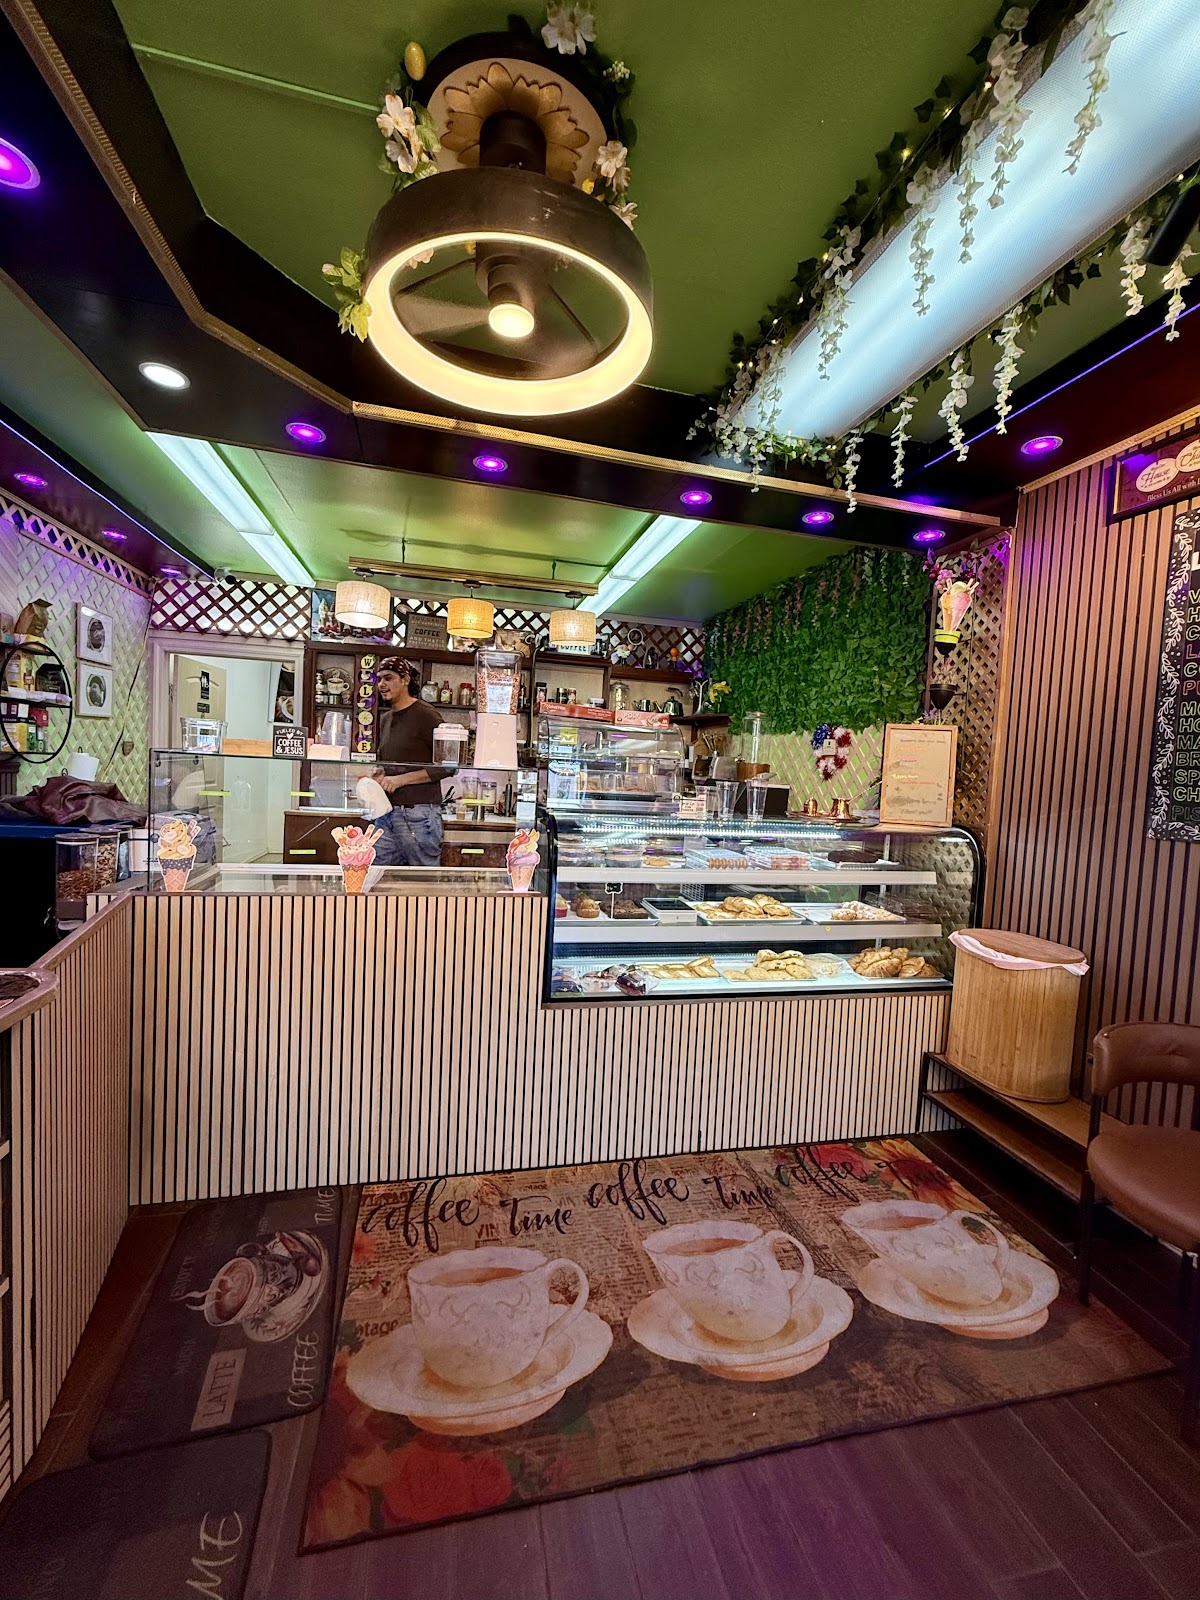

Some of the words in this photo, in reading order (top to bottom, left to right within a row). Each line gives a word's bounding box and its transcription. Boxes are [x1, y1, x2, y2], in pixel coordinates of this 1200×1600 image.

[1147, 494, 1163, 502] Bless
[1163, 489, 1172, 497] Us
[1171, 485, 1182, 494] All
[1182, 480, 1197, 490] with
[414, 628, 441, 637] COFFEE
[275, 745, 283, 754] &
[283, 746, 304, 755] JESUS
[278, 738, 302, 747] COFFEE
[314, 1188, 335, 1225] TIME
[586, 1158, 690, 1225] coffee
[702, 1173, 776, 1210] Time
[361, 1177, 480, 1253] coffee
[499, 1195, 574, 1237] Time
[286, 1330, 320, 1408] COFFEE
[202, 1358, 236, 1418] LATTE
